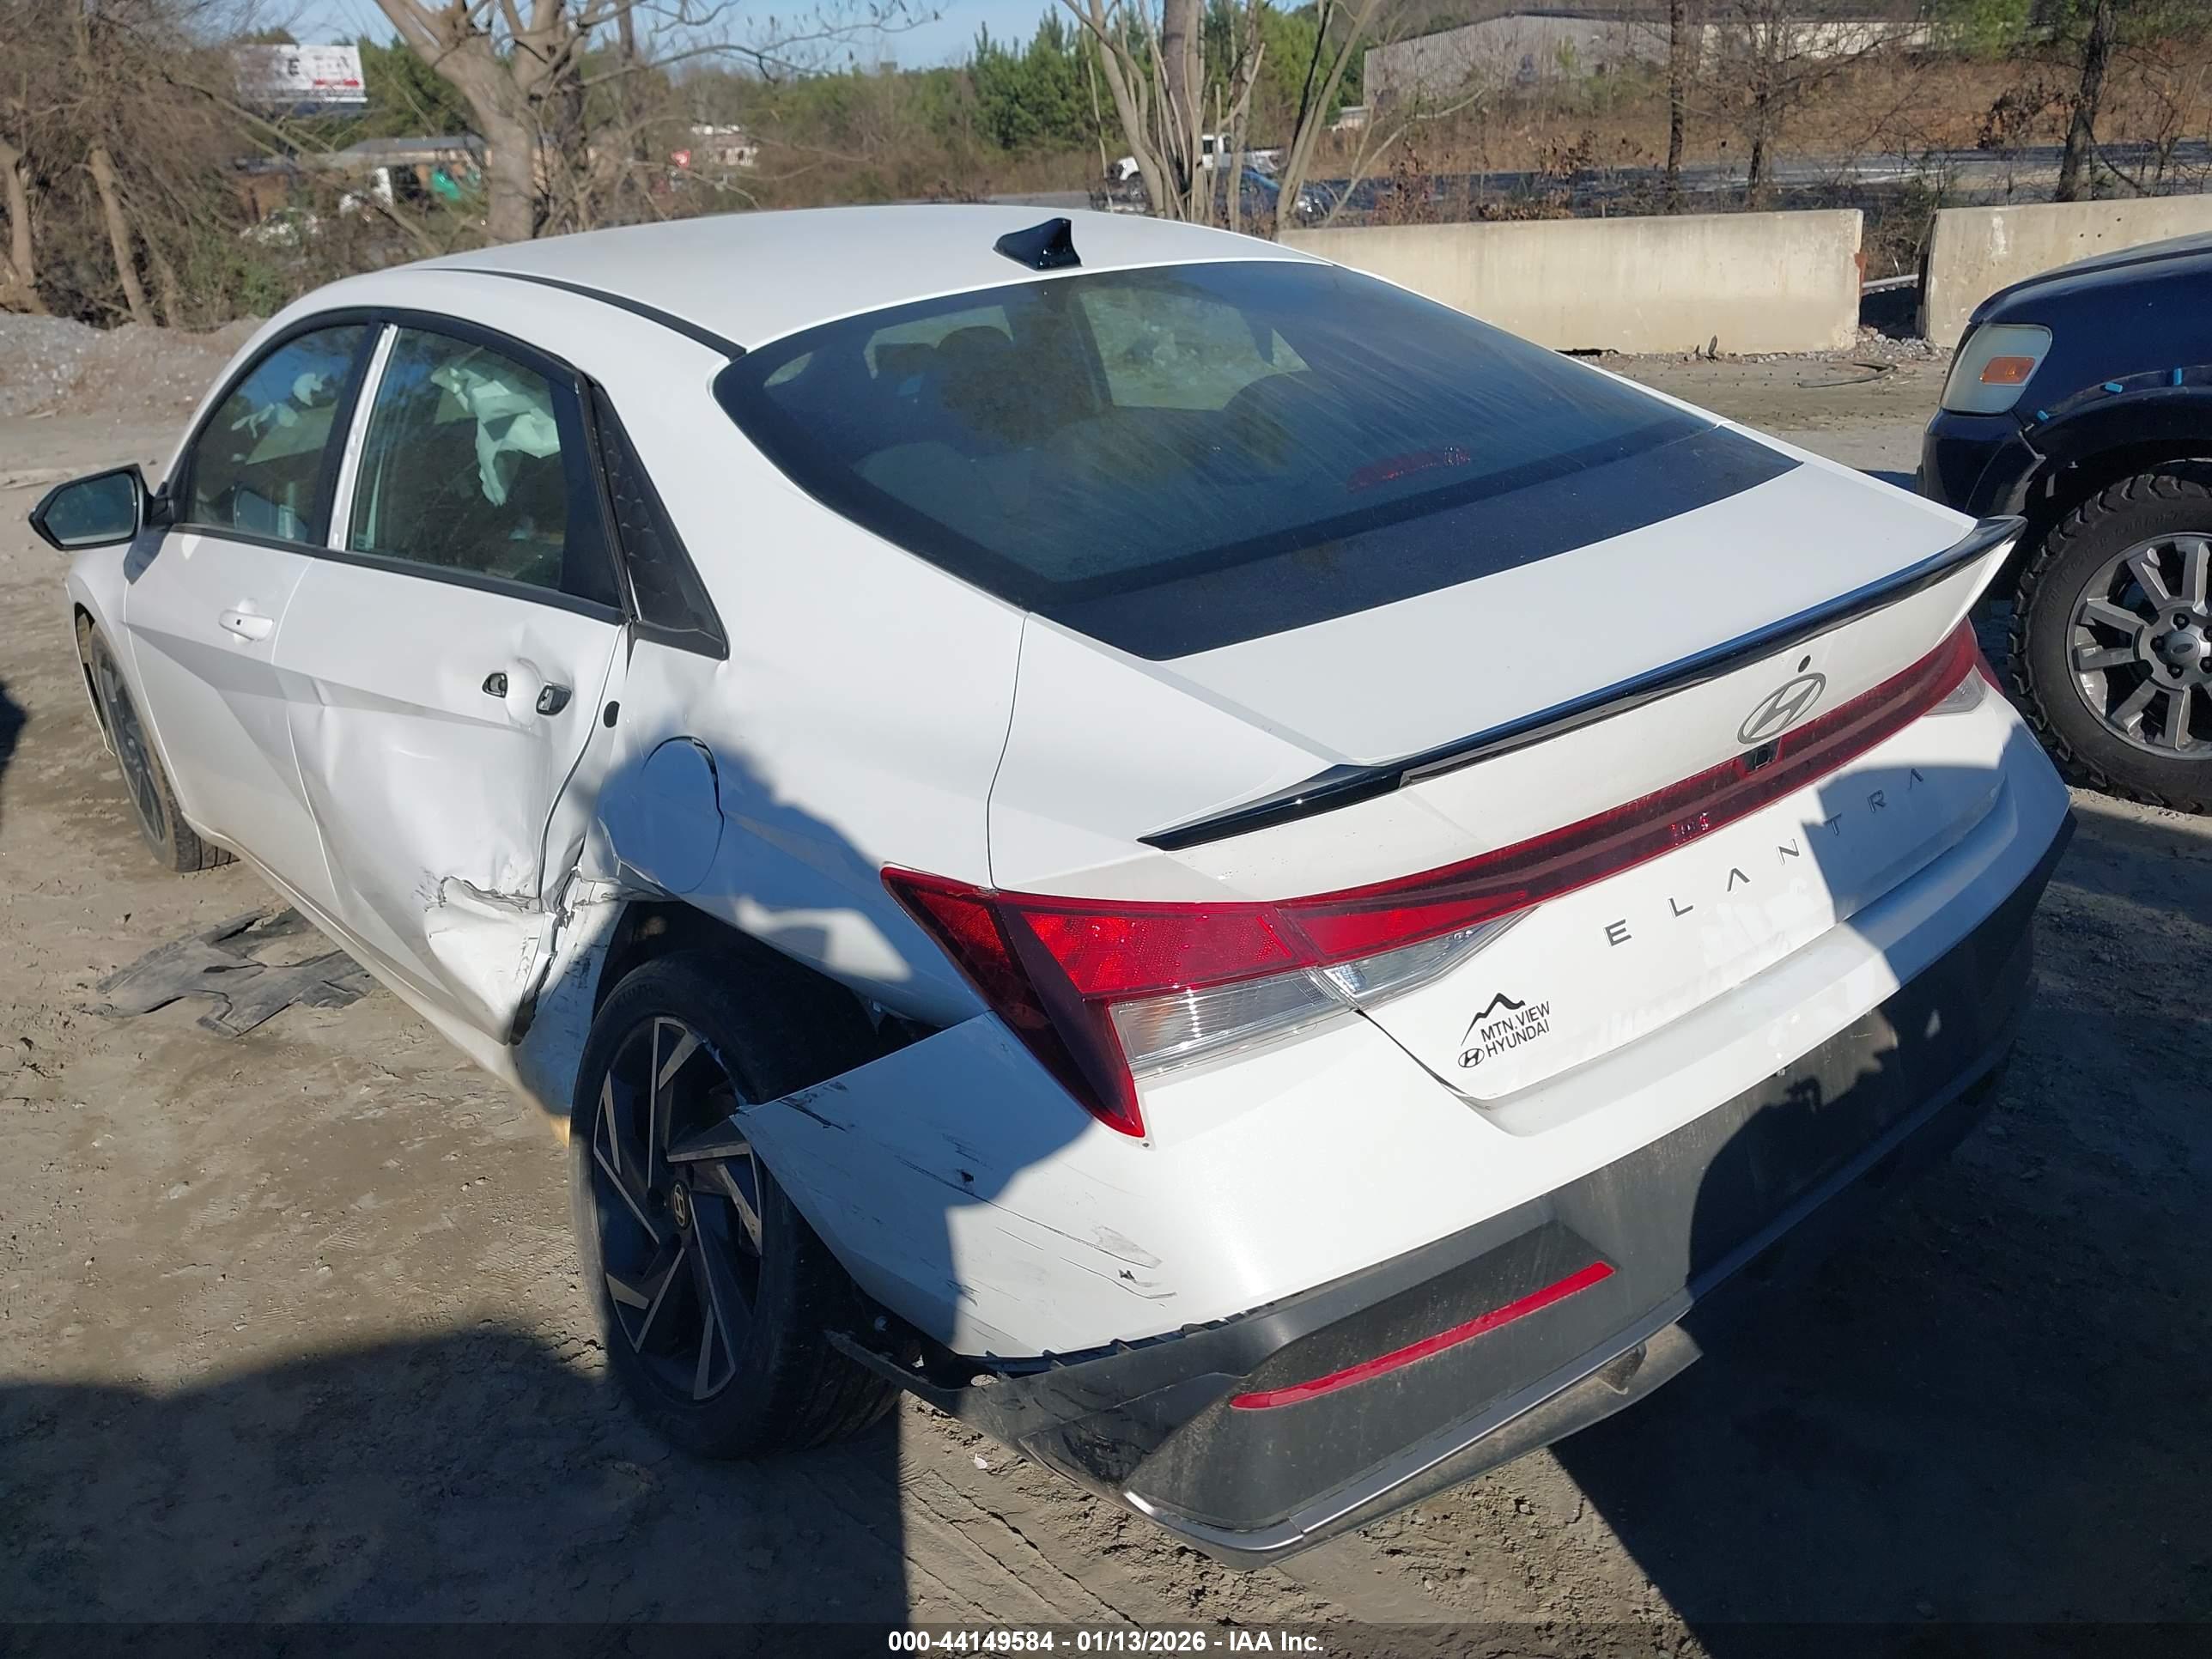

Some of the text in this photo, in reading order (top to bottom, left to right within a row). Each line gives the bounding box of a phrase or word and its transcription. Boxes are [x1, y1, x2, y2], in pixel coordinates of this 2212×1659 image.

[1603, 768, 1924, 946] ELANTRA
[1480, 1000, 1550, 1042] MTN. VIEW
[1485, 1018, 1550, 1057] HYUNDAI
